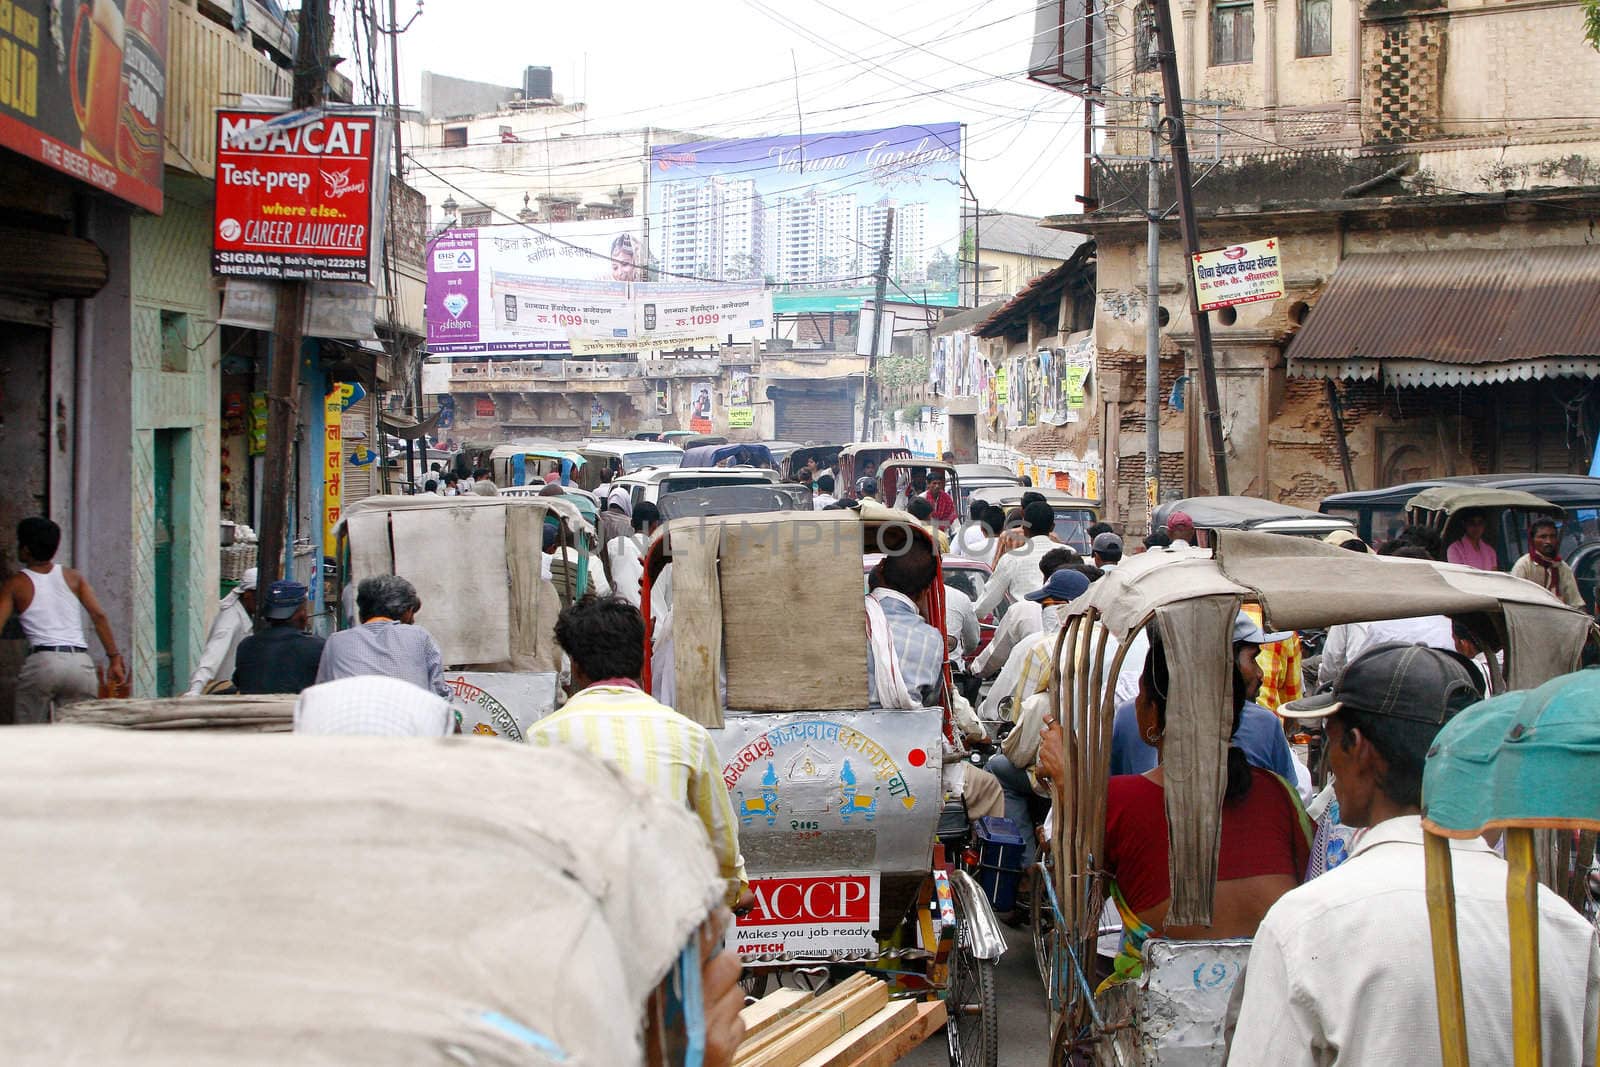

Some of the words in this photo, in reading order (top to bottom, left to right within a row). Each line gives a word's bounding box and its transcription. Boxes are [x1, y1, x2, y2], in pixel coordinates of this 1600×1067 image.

[40, 138, 61, 166] THE
[63, 149, 90, 179] BEER
[90, 162, 118, 190] SHOP
[768, 146, 849, 175] Varuna
[220, 163, 311, 195] Test-prep
[262, 202, 306, 216] where
[244, 220, 293, 245] CAREER
[296, 222, 365, 247] LAUNCHER
[521, 237, 532, 249] के
[220, 252, 265, 265] SIGRA
[328, 258, 366, 269] 2222915
[220, 265, 282, 279] BHELUPUR,
[1197, 263, 1215, 280] शिवा
[741, 881, 866, 922] ACCP
[736, 929, 778, 940] Makes
[781, 928, 804, 941] you
[807, 927, 829, 940] job
[833, 926, 870, 940] ready
[736, 943, 785, 954] APTECH
